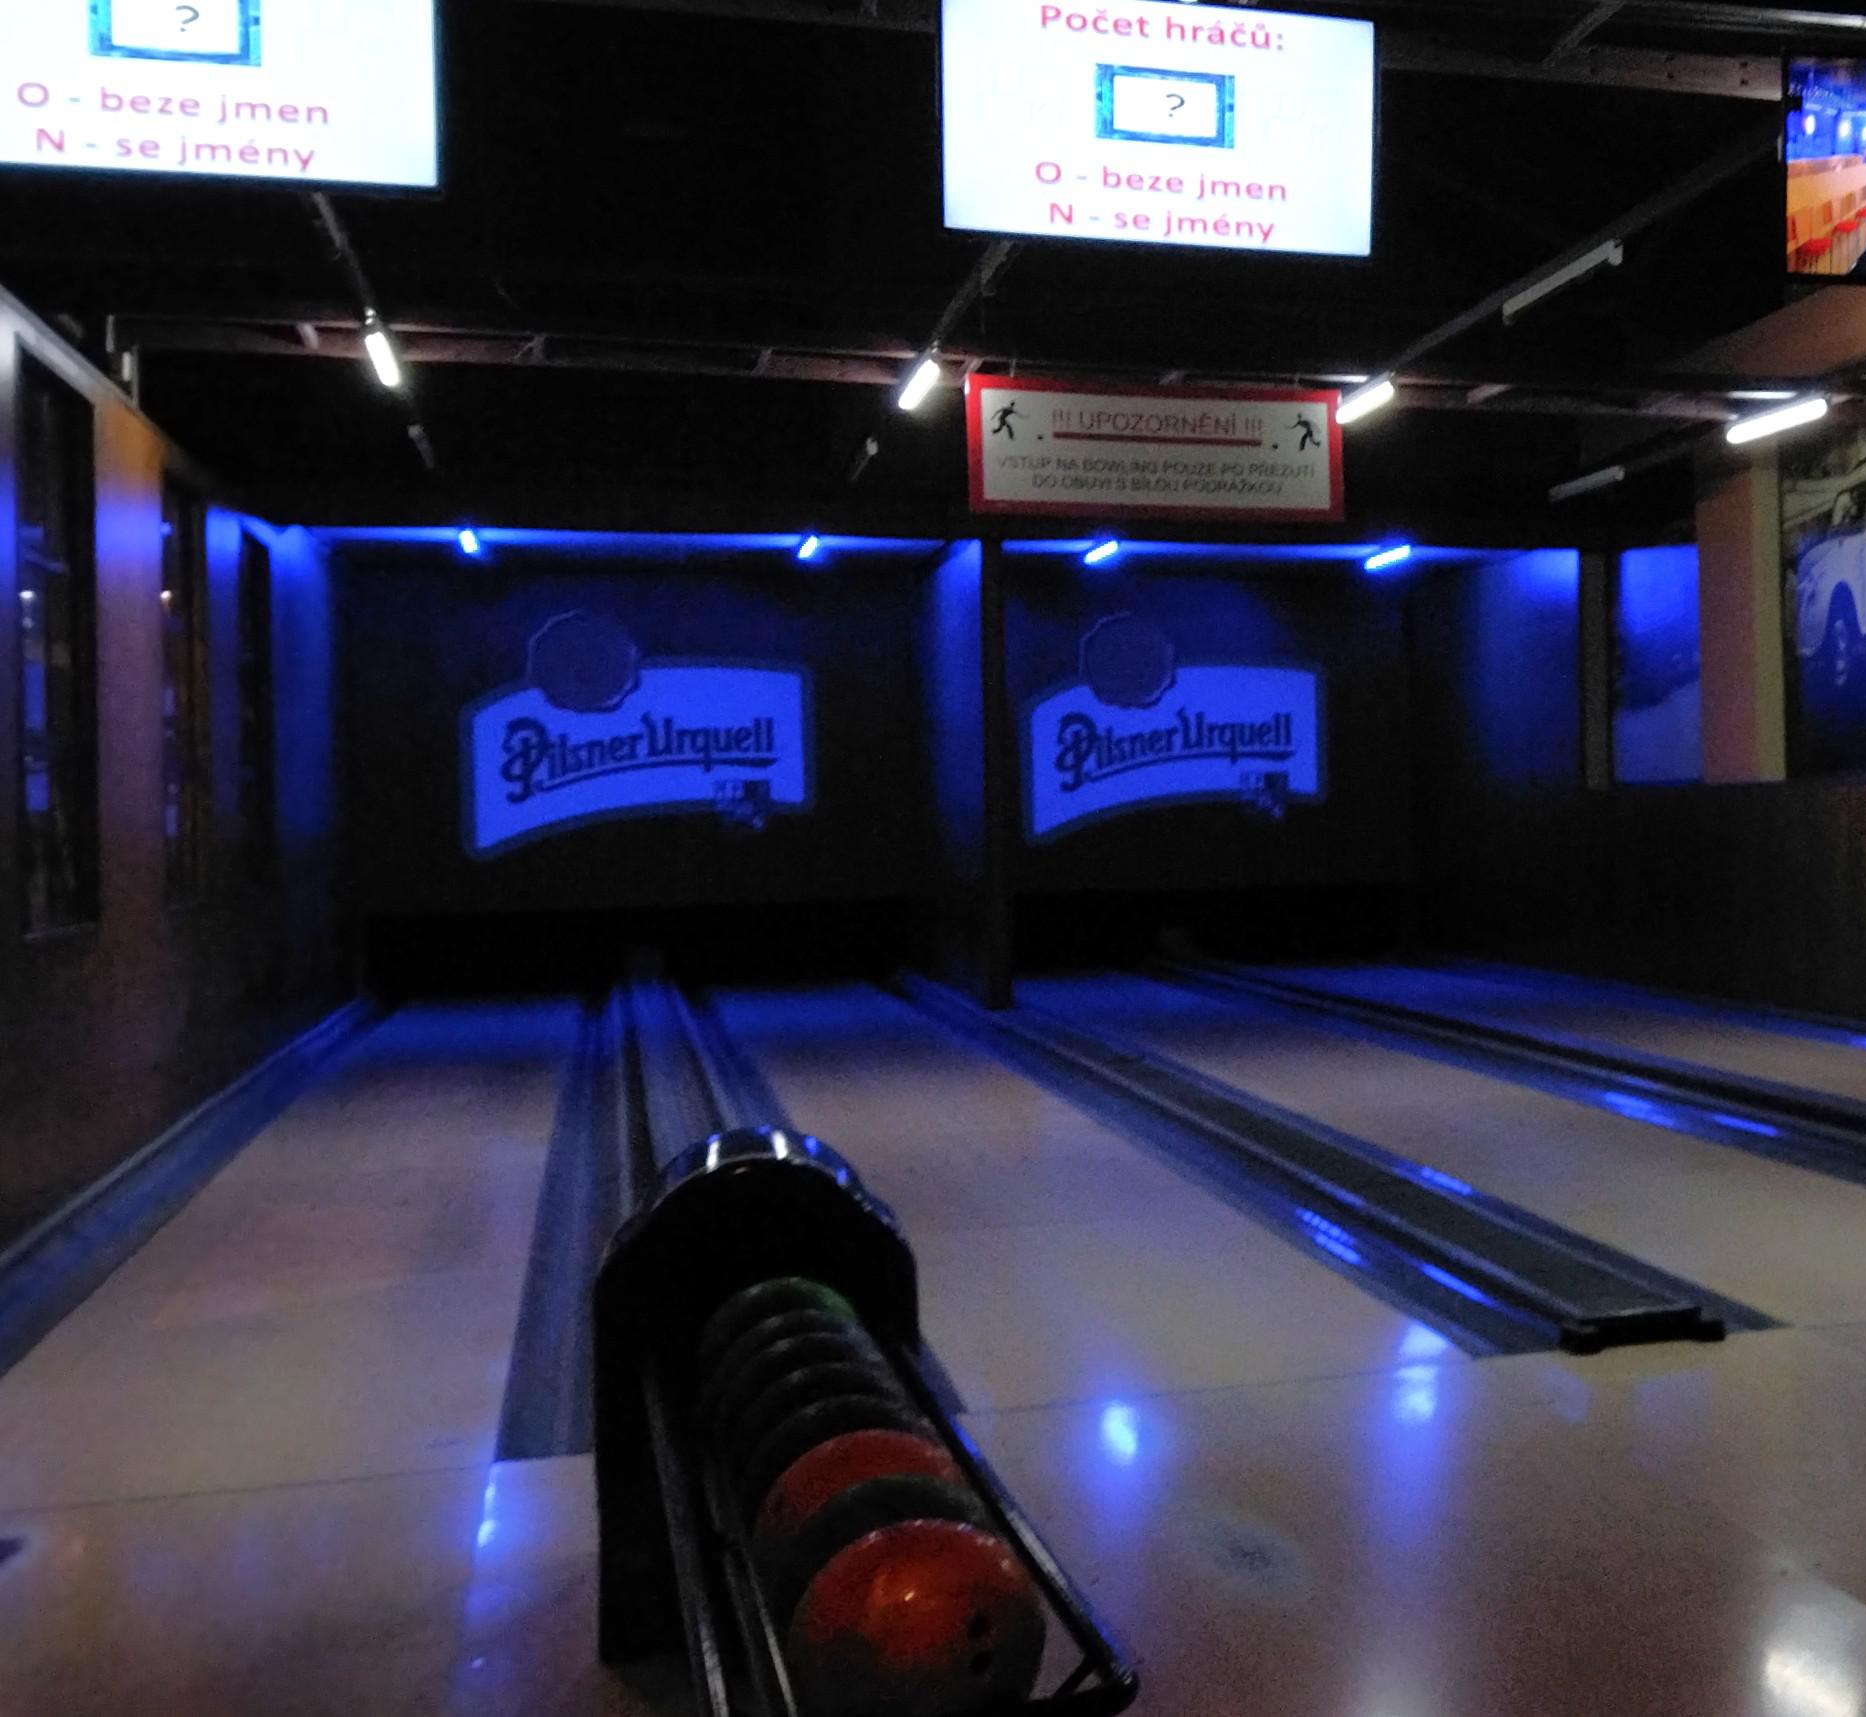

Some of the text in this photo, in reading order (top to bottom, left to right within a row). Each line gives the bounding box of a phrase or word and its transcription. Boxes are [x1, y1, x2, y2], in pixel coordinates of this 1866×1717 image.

[1040, 4, 1286, 51] Počet hráčů:
[16, 82, 50, 108] O
[100, 86, 202, 118] beze
[217, 94, 330, 126] jmen
[35, 129, 66, 153] N
[116, 135, 160, 160] se
[178, 135, 316, 172] jmény
[1034, 161, 1063, 185] O
[1102, 165, 1184, 193] beze
[1198, 174, 1287, 201] jmen
[1048, 203, 1074, 224] N
[1114, 209, 1150, 230] se
[1163, 209, 1275, 243] jmény
[1079, 409, 1237, 435] UPOZORNĚNÍ
[502, 712, 774, 803] Pilsner Urquell
[1055, 706, 1292, 793] Pilsner Urquell
